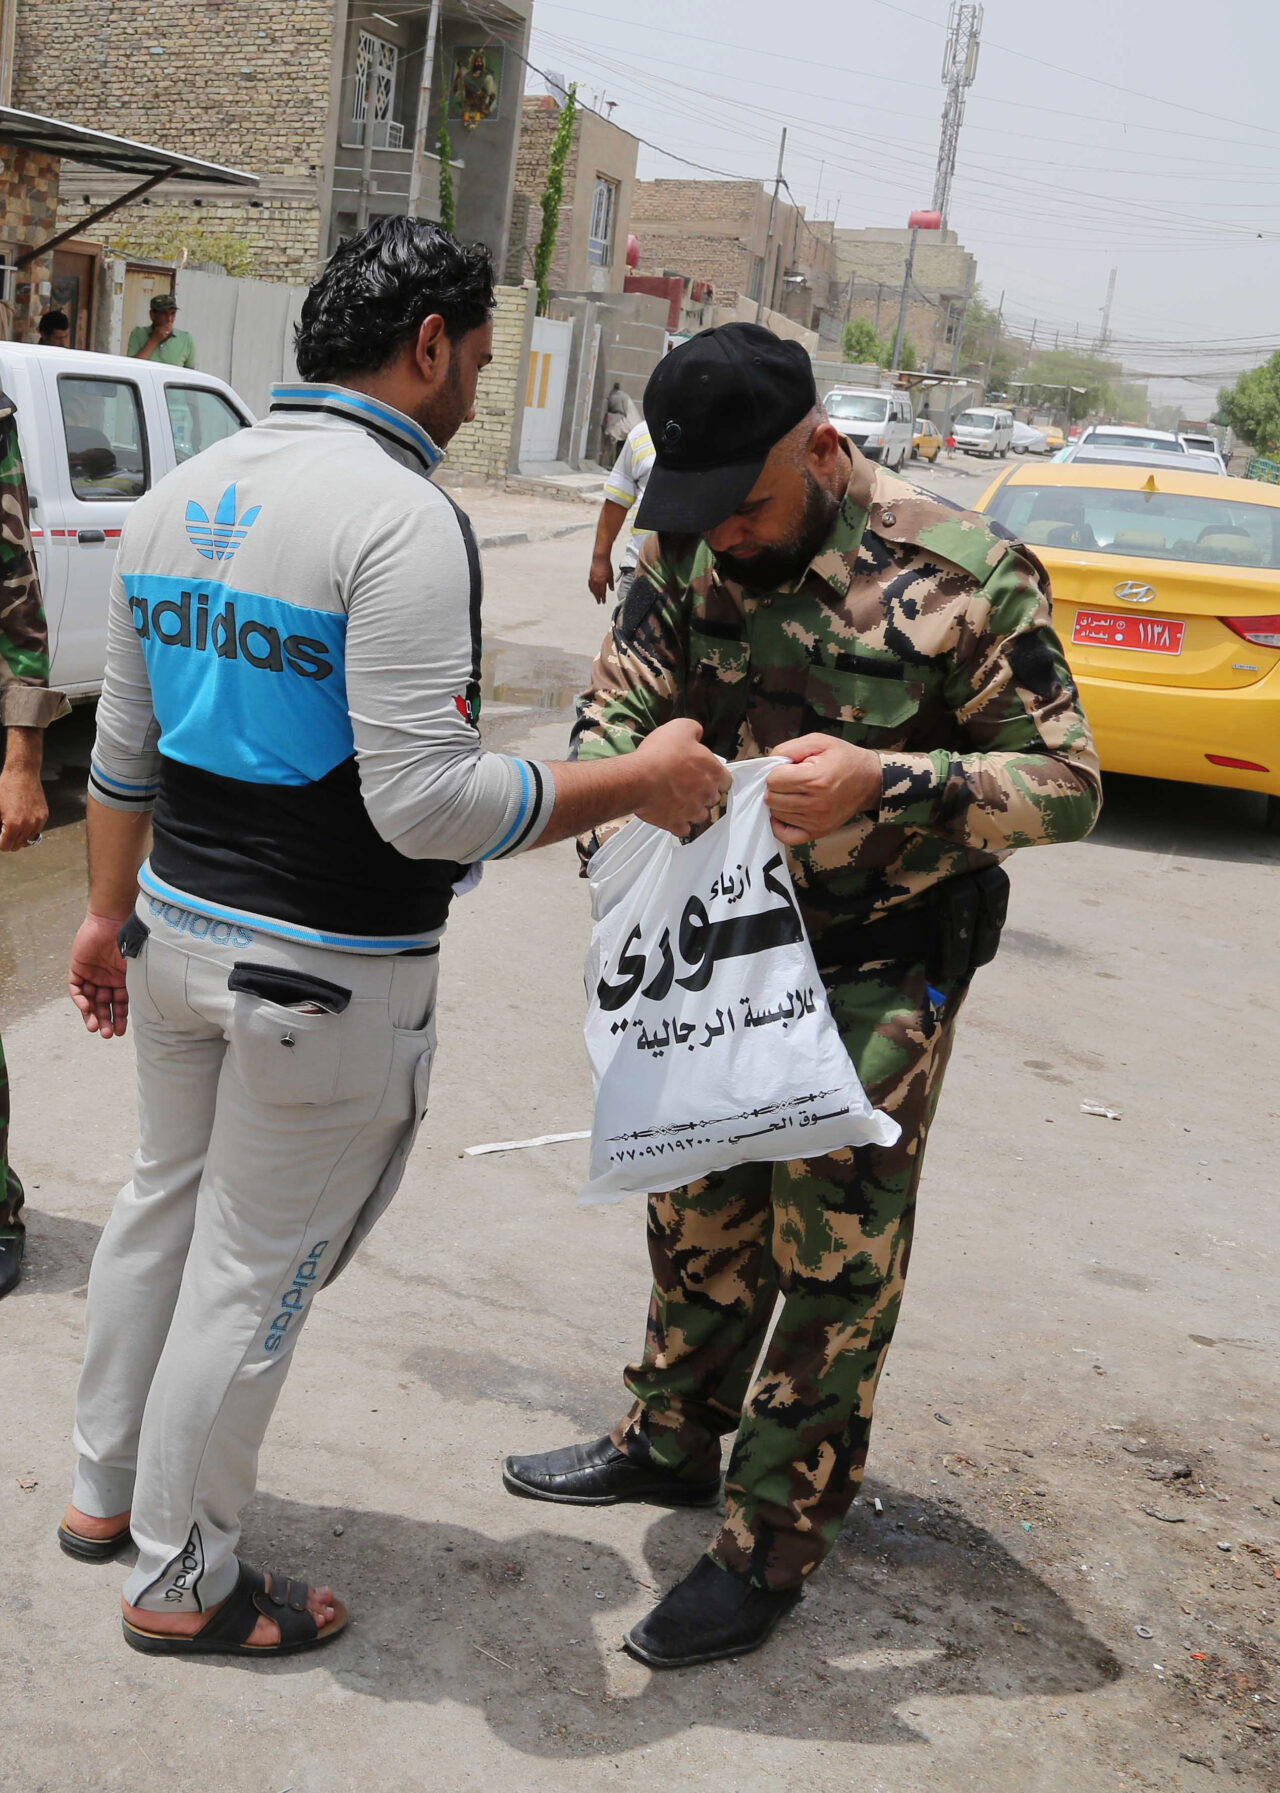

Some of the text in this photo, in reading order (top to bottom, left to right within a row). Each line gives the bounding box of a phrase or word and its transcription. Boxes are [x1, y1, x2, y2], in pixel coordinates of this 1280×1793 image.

[128, 591, 333, 681] adidas
[1080, 616, 1114, 627] العراق
[1080, 629, 1109, 641] بغداد
[708, 863, 752, 904] ازياء
[597, 852, 804, 1036] كوري
[632, 987, 817, 1058] للالبسة الرجالية
[728, 1116, 794, 1144] الحي
[799, 1104, 850, 1128] سوق
[264, 1239, 329, 1353] adidas
[164, 1540, 198, 1603] adida
